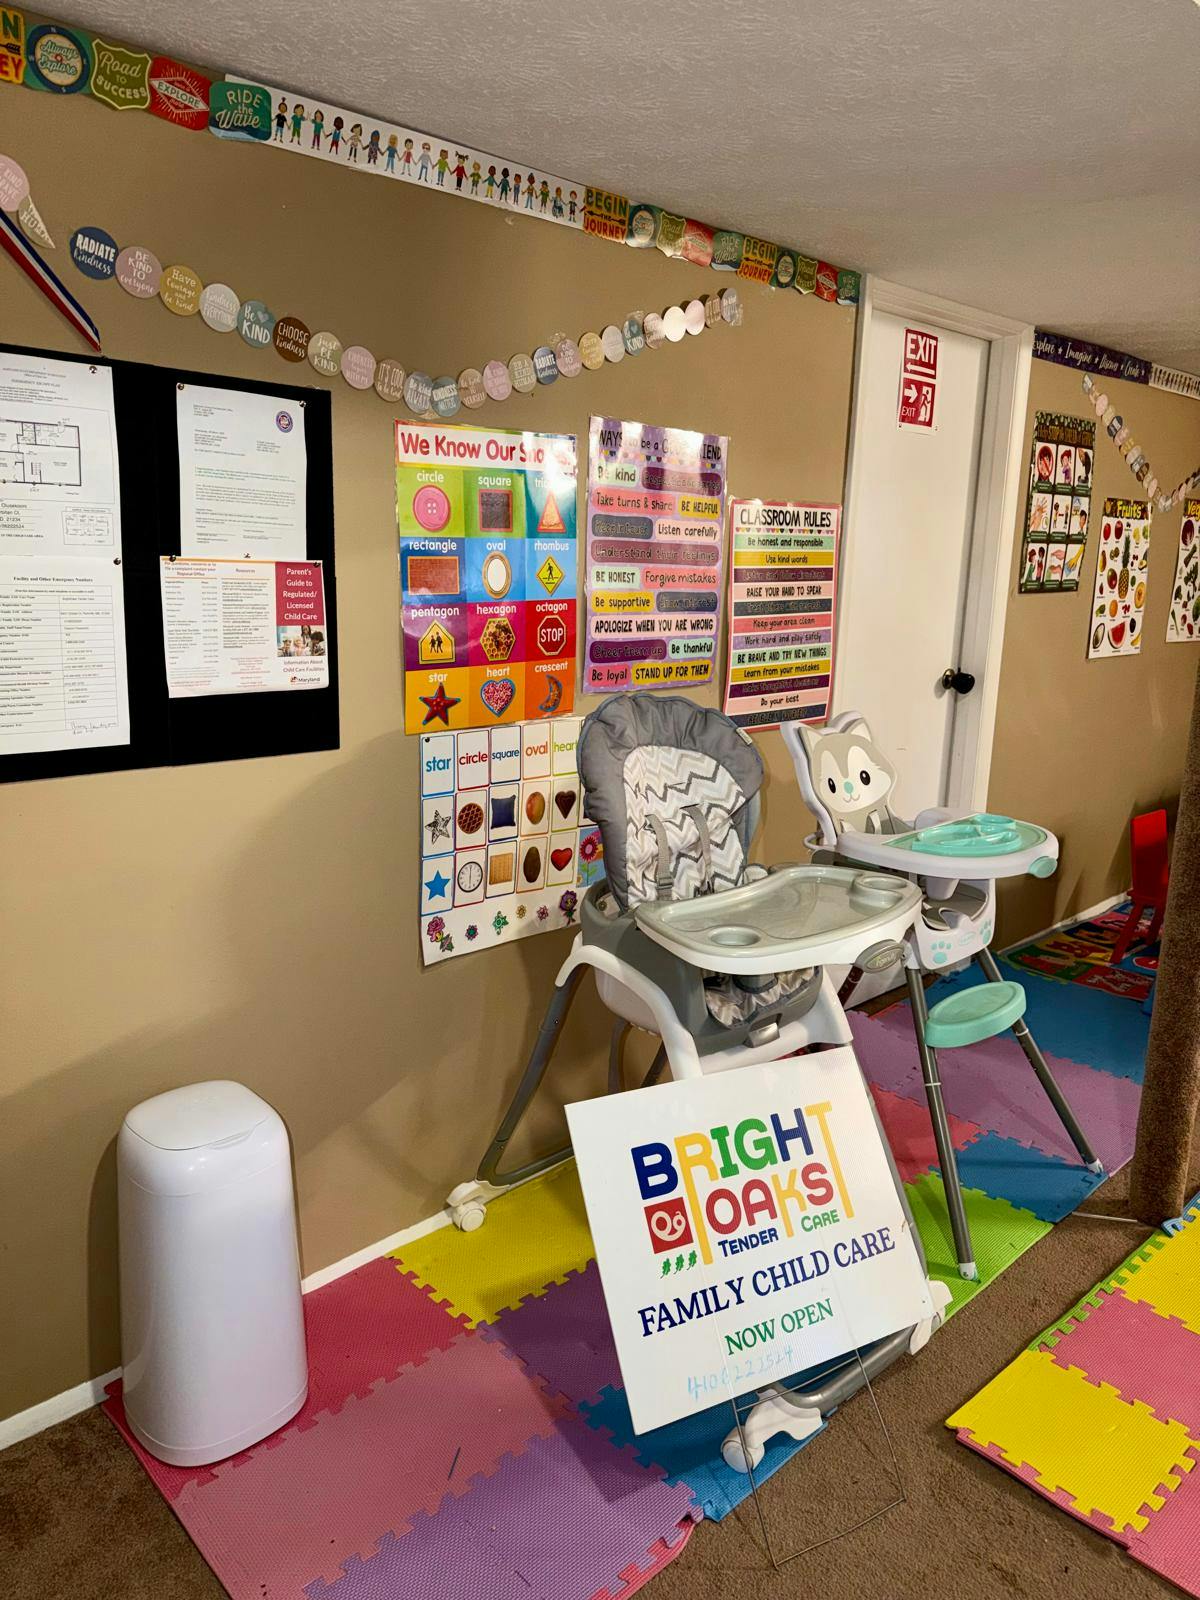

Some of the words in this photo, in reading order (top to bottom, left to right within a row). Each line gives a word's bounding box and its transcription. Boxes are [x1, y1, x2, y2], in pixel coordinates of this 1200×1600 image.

[40, 40, 79, 60] Always
[38, 54, 78, 77] Explore
[99, 51, 142, 78] Road
[96, 75, 148, 99] SUCCESS
[157, 81, 201, 108] EXPLORE
[226, 89, 262, 107] RIDE
[238, 103, 253, 115] the
[215, 110, 261, 129] Wave
[585, 188, 629, 219] BEGIN
[584, 215, 627, 241] JOURNEY
[76, 233, 116, 262] RADIATE
[721, 235, 740, 250] RIDE
[744, 237, 777, 262] BEGIN
[135, 250, 151, 262] BE
[128, 257, 153, 274] KIND
[741, 263, 773, 283] JOURNEY
[133, 268, 146, 281] TO
[171, 268, 196, 288] Have
[244, 305, 257, 322] Be
[242, 321, 271, 344] KIND
[278, 322, 309, 346] CHOOSE
[626, 336, 644, 351] KIND
[906, 332, 937, 365] EXIT
[320, 347, 331, 361] BE
[1064, 342, 1092, 370] Imagine
[314, 355, 338, 372] KIND
[901, 406, 916, 418] EXIT
[400, 431, 430, 456] We
[434, 434, 482, 460] Know
[485, 438, 516, 462] Our
[641, 440, 651, 452] be
[654, 443, 659, 453] a
[416, 470, 444, 483] circle
[477, 476, 512, 488] square
[615, 467, 636, 482] kind
[597, 493, 614, 506] Take
[617, 495, 641, 508] turns
[651, 499, 673, 511] share
[681, 501, 690, 511] BE
[692, 499, 719, 514] HELPFUL
[1117, 501, 1143, 519] Fruits
[740, 509, 802, 527] CLASSROOM
[804, 510, 832, 528] RULES
[658, 522, 681, 537] Listen
[684, 525, 718, 541] carefully
[409, 539, 458, 552] rectangle
[485, 539, 506, 550] oval
[534, 540, 569, 551] rhombus
[748, 537, 756, 546] Be
[758, 537, 779, 547] honest
[780, 539, 792, 547] and
[793, 539, 824, 549] responsible
[595, 545, 652, 560] Understand
[766, 554, 776, 563] Use
[777, 554, 790, 563] kind
[791, 555, 809, 564] words
[286, 567, 312, 577] Parent's
[595, 571, 605, 583] BE
[608, 571, 636, 584] HONEST
[645, 570, 676, 587] Forgive
[677, 569, 716, 584] mistakes
[286, 579, 304, 587] Guide
[306, 579, 313, 587] to
[283, 590, 317, 599] Regulated/
[746, 587, 763, 598] RAISE
[765, 586, 781, 598] YOUR
[782, 586, 796, 597] HAND
[797, 586, 805, 596] TO
[806, 585, 822, 596] SPEAK
[286, 602, 314, 610] Licensed
[476, 604, 517, 617] hexagon
[535, 602, 568, 614] octagon
[595, 596, 606, 607] Be
[608, 596, 651, 611] supportive
[284, 613, 300, 621] Child
[302, 613, 317, 621] Care
[411, 606, 460, 621] pentagon
[594, 621, 633, 634] APOLOGIZE
[636, 620, 656, 633] WHEN
[658, 619, 673, 631] YOU
[675, 618, 688, 631] ARE
[690, 617, 714, 631] WRONG
[753, 620, 769, 630] Keep
[770, 618, 784, 631] your
[785, 617, 797, 626] area
[799, 617, 816, 625] clean
[540, 628, 564, 643] STOP
[745, 635, 760, 646] Work
[762, 634, 777, 644] hard
[779, 633, 789, 643] and
[791, 632, 804, 643] play
[805, 632, 822, 642] safely
[671, 644, 681, 654] Be
[683, 643, 712, 654] thankful
[737, 653, 746, 664] BE
[748, 651, 767, 663] BRAVE
[769, 650, 781, 661] AND
[783, 649, 793, 660] TRY
[794, 649, 807, 658] NEW
[808, 647, 827, 658] THINGS
[486, 666, 511, 679] heart
[534, 661, 568, 674] crescent
[635, 667, 660, 680] STAND
[663, 667, 673, 679] UP
[675, 666, 688, 678] FOR
[691, 664, 709, 677] THEM
[743, 666, 761, 678] Learn
[763, 665, 779, 676] from
[780, 664, 794, 675] your
[795, 662, 821, 673] mistakes
[298, 676, 321, 685] Maryland
[428, 671, 448, 683] star
[591, 669, 603, 681] Be
[606, 669, 628, 684] loyal
[761, 697, 768, 706] Do
[770, 696, 784, 708] your
[785, 694, 800, 704] best
[425, 756, 451, 773] star
[458, 751, 488, 766] circle
[491, 748, 520, 762] square
[525, 741, 549, 758] oval
[631, 1100, 855, 1265] BRIGHT
[706, 1162, 835, 1238] OAKS
[718, 1228, 779, 1257] TENDER
[801, 1208, 840, 1233] CARE
[638, 1276, 745, 1337] FAMILY
[752, 1249, 831, 1298] CHILD
[834, 1226, 896, 1273] CARE
[725, 1318, 775, 1356] NOW
[781, 1297, 834, 1334] OPEN
